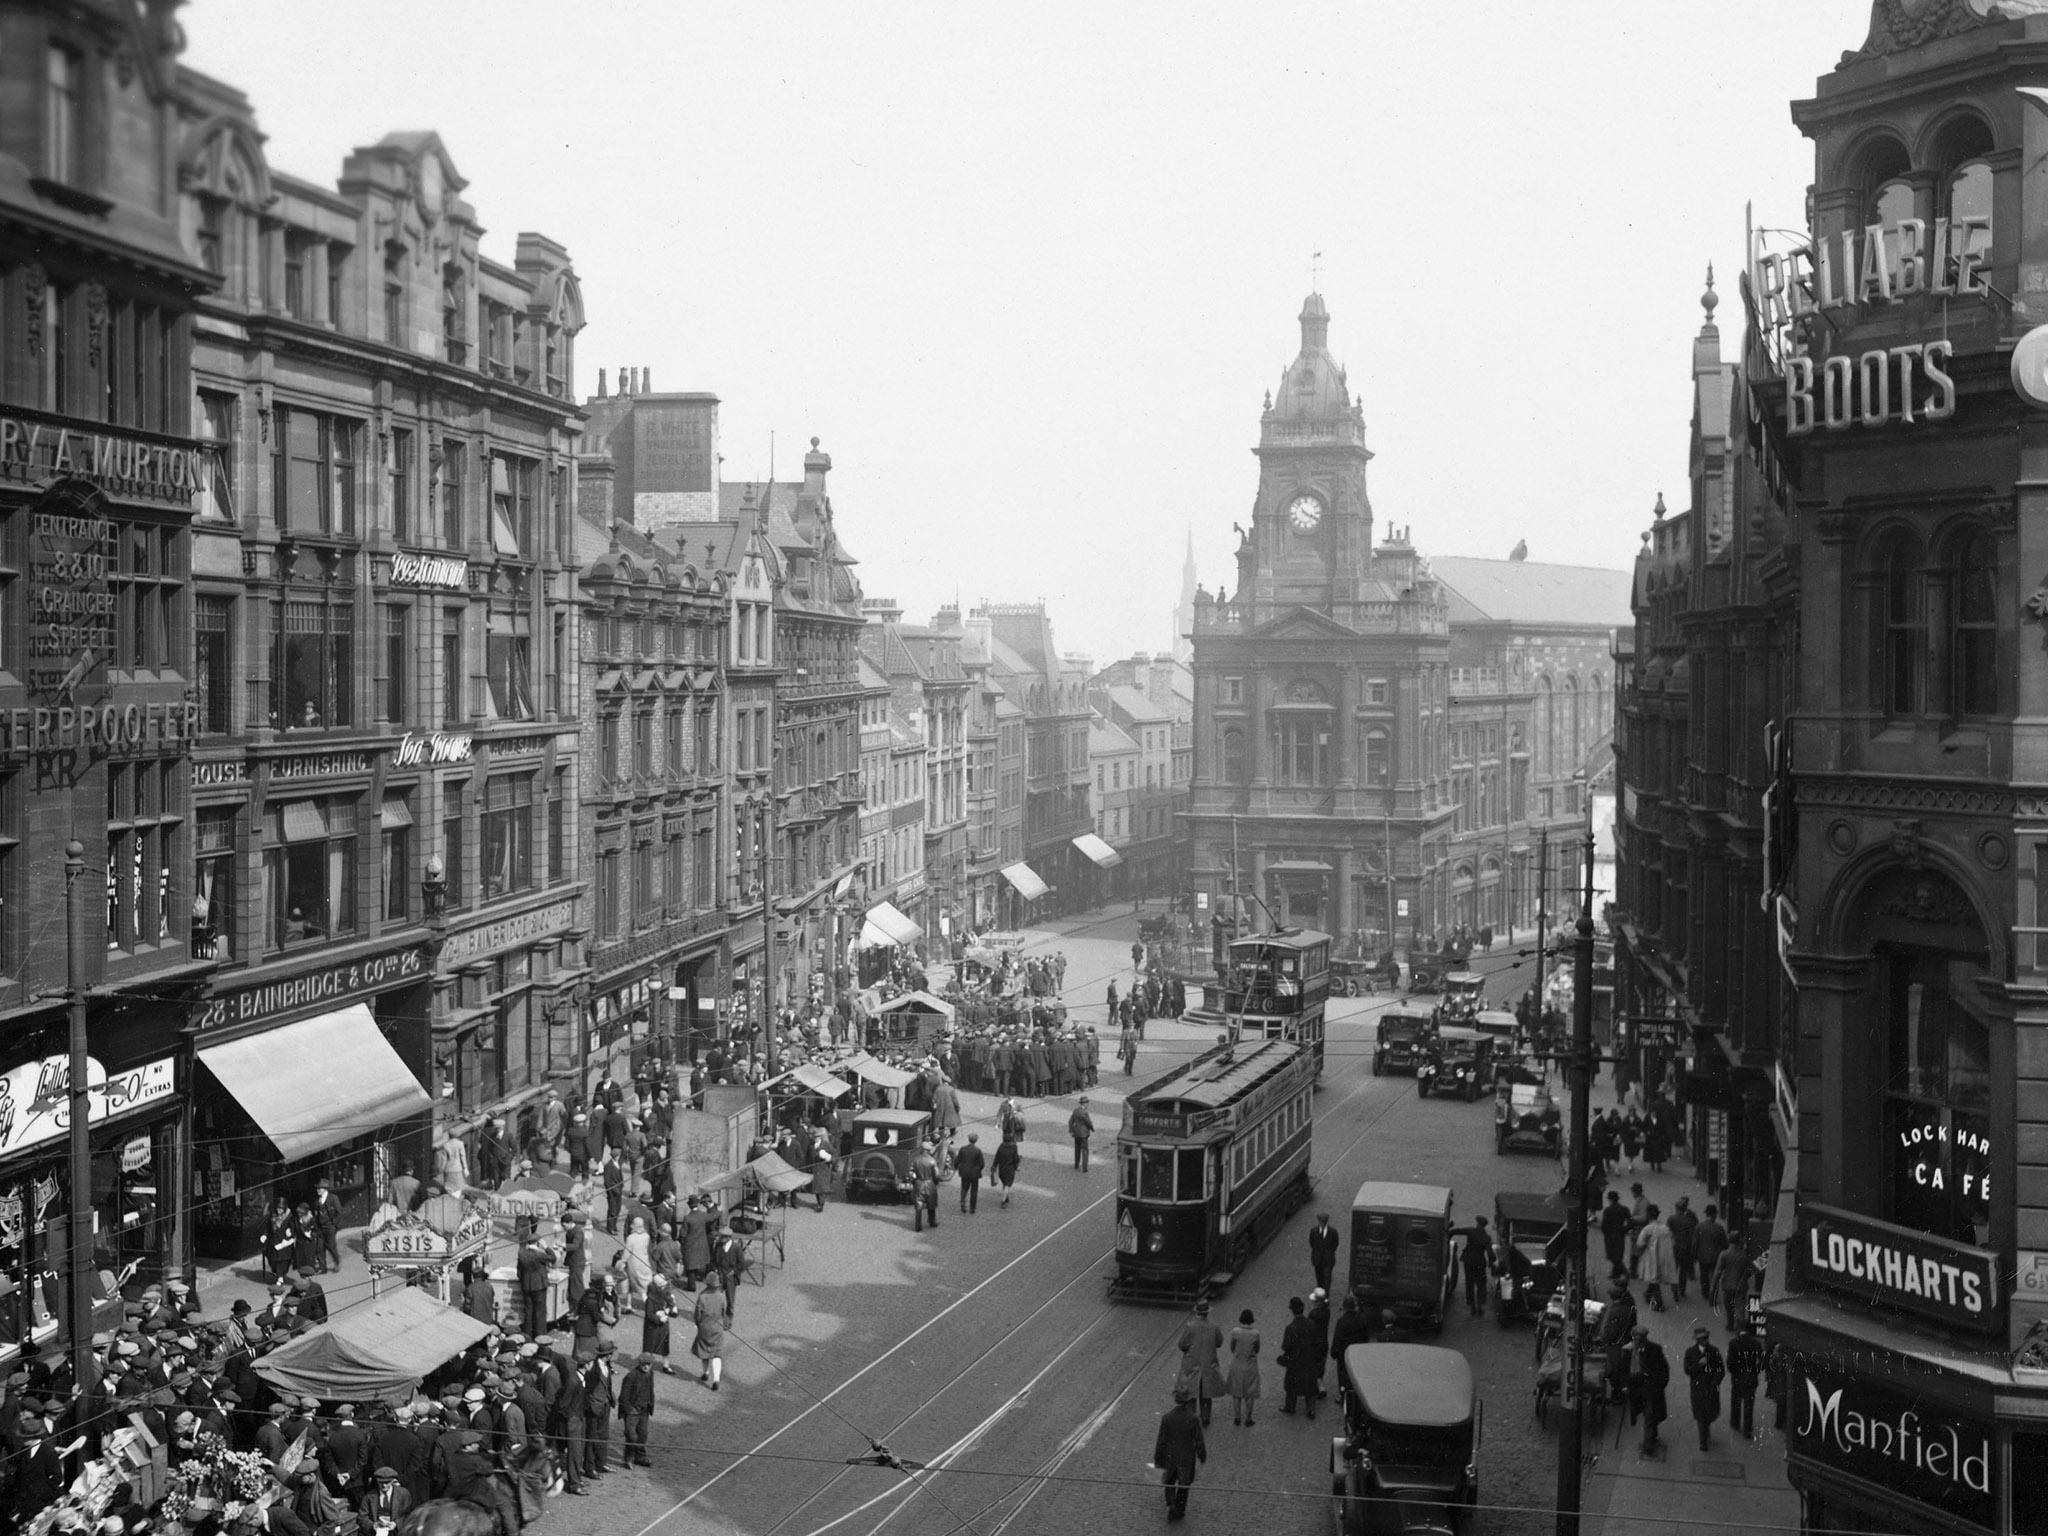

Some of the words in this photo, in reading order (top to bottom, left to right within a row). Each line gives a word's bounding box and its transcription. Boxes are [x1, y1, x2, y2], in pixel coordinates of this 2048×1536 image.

[1756, 216, 1991, 333] RELIABLE
[1786, 340, 1956, 437] BOOTS
[93, 437, 205, 492] MURTON
[40, 515, 117, 541] ENTRANCE
[41, 586, 115, 614] GRAINGER
[48, 623, 109, 649] STREET
[0, 701, 201, 753] ERPROOFER
[191, 760, 246, 787] HOUSE
[270, 753, 367, 780] FURNISHING
[239, 968, 344, 1019] BAINBRIDGE
[349, 965, 359, 989] &
[402, 948, 421, 974] 26
[144, 1081, 171, 1098] EXTRAS
[153, 1064, 163, 1075] NO
[1810, 1227, 1983, 1313] LOCKHARTS
[1566, 1336, 1579, 1403] STOP
[1798, 1377, 1992, 1494] Manfield
